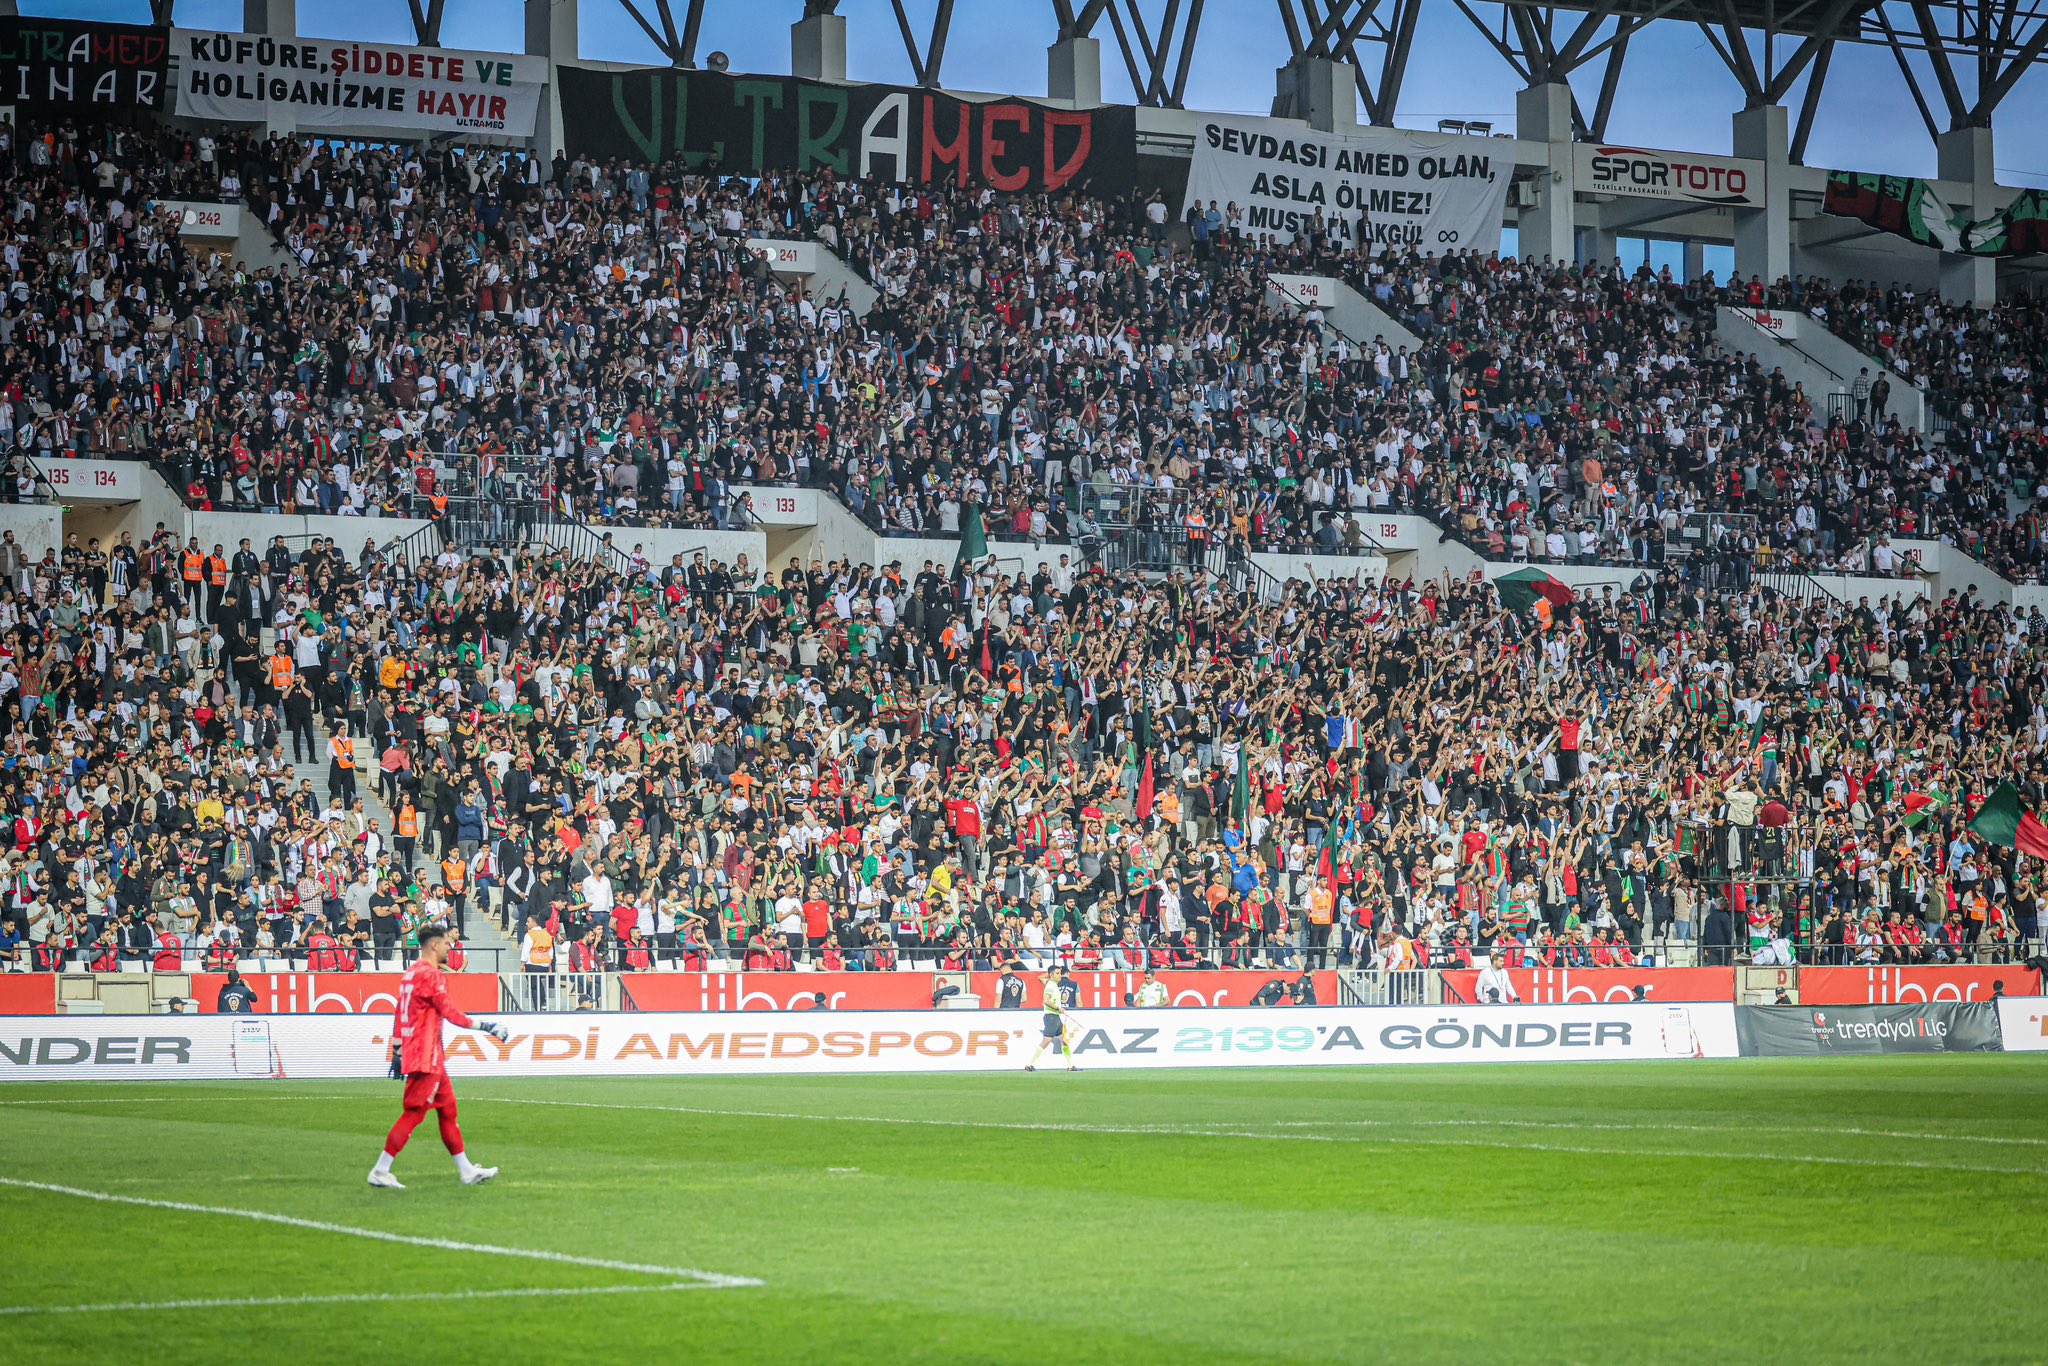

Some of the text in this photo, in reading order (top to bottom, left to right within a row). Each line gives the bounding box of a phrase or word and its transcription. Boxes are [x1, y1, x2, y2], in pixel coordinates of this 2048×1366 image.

[0, 29, 166, 65] TRAMED
[475, 60, 513, 86] VE
[190, 70, 507, 121] HOLİGANİZME HAYIR
[1205, 124, 1495, 183] SEVDASI AMED OLAN,
[1250, 172, 1432, 215] ASLA ÖLMEZ!
[199, 212, 220, 225] 242
[779, 249, 797, 262] 241
[1300, 284, 1318, 296] 240
[48, 469, 117, 486] 135 134
[776, 498, 795, 513] 133
[1380, 524, 1397, 538] 132
[1777, 969, 1787, 985] D
[1379, 1018, 1633, 1049] GÖNDER
[1836, 1018, 1915, 1042] trendyol
